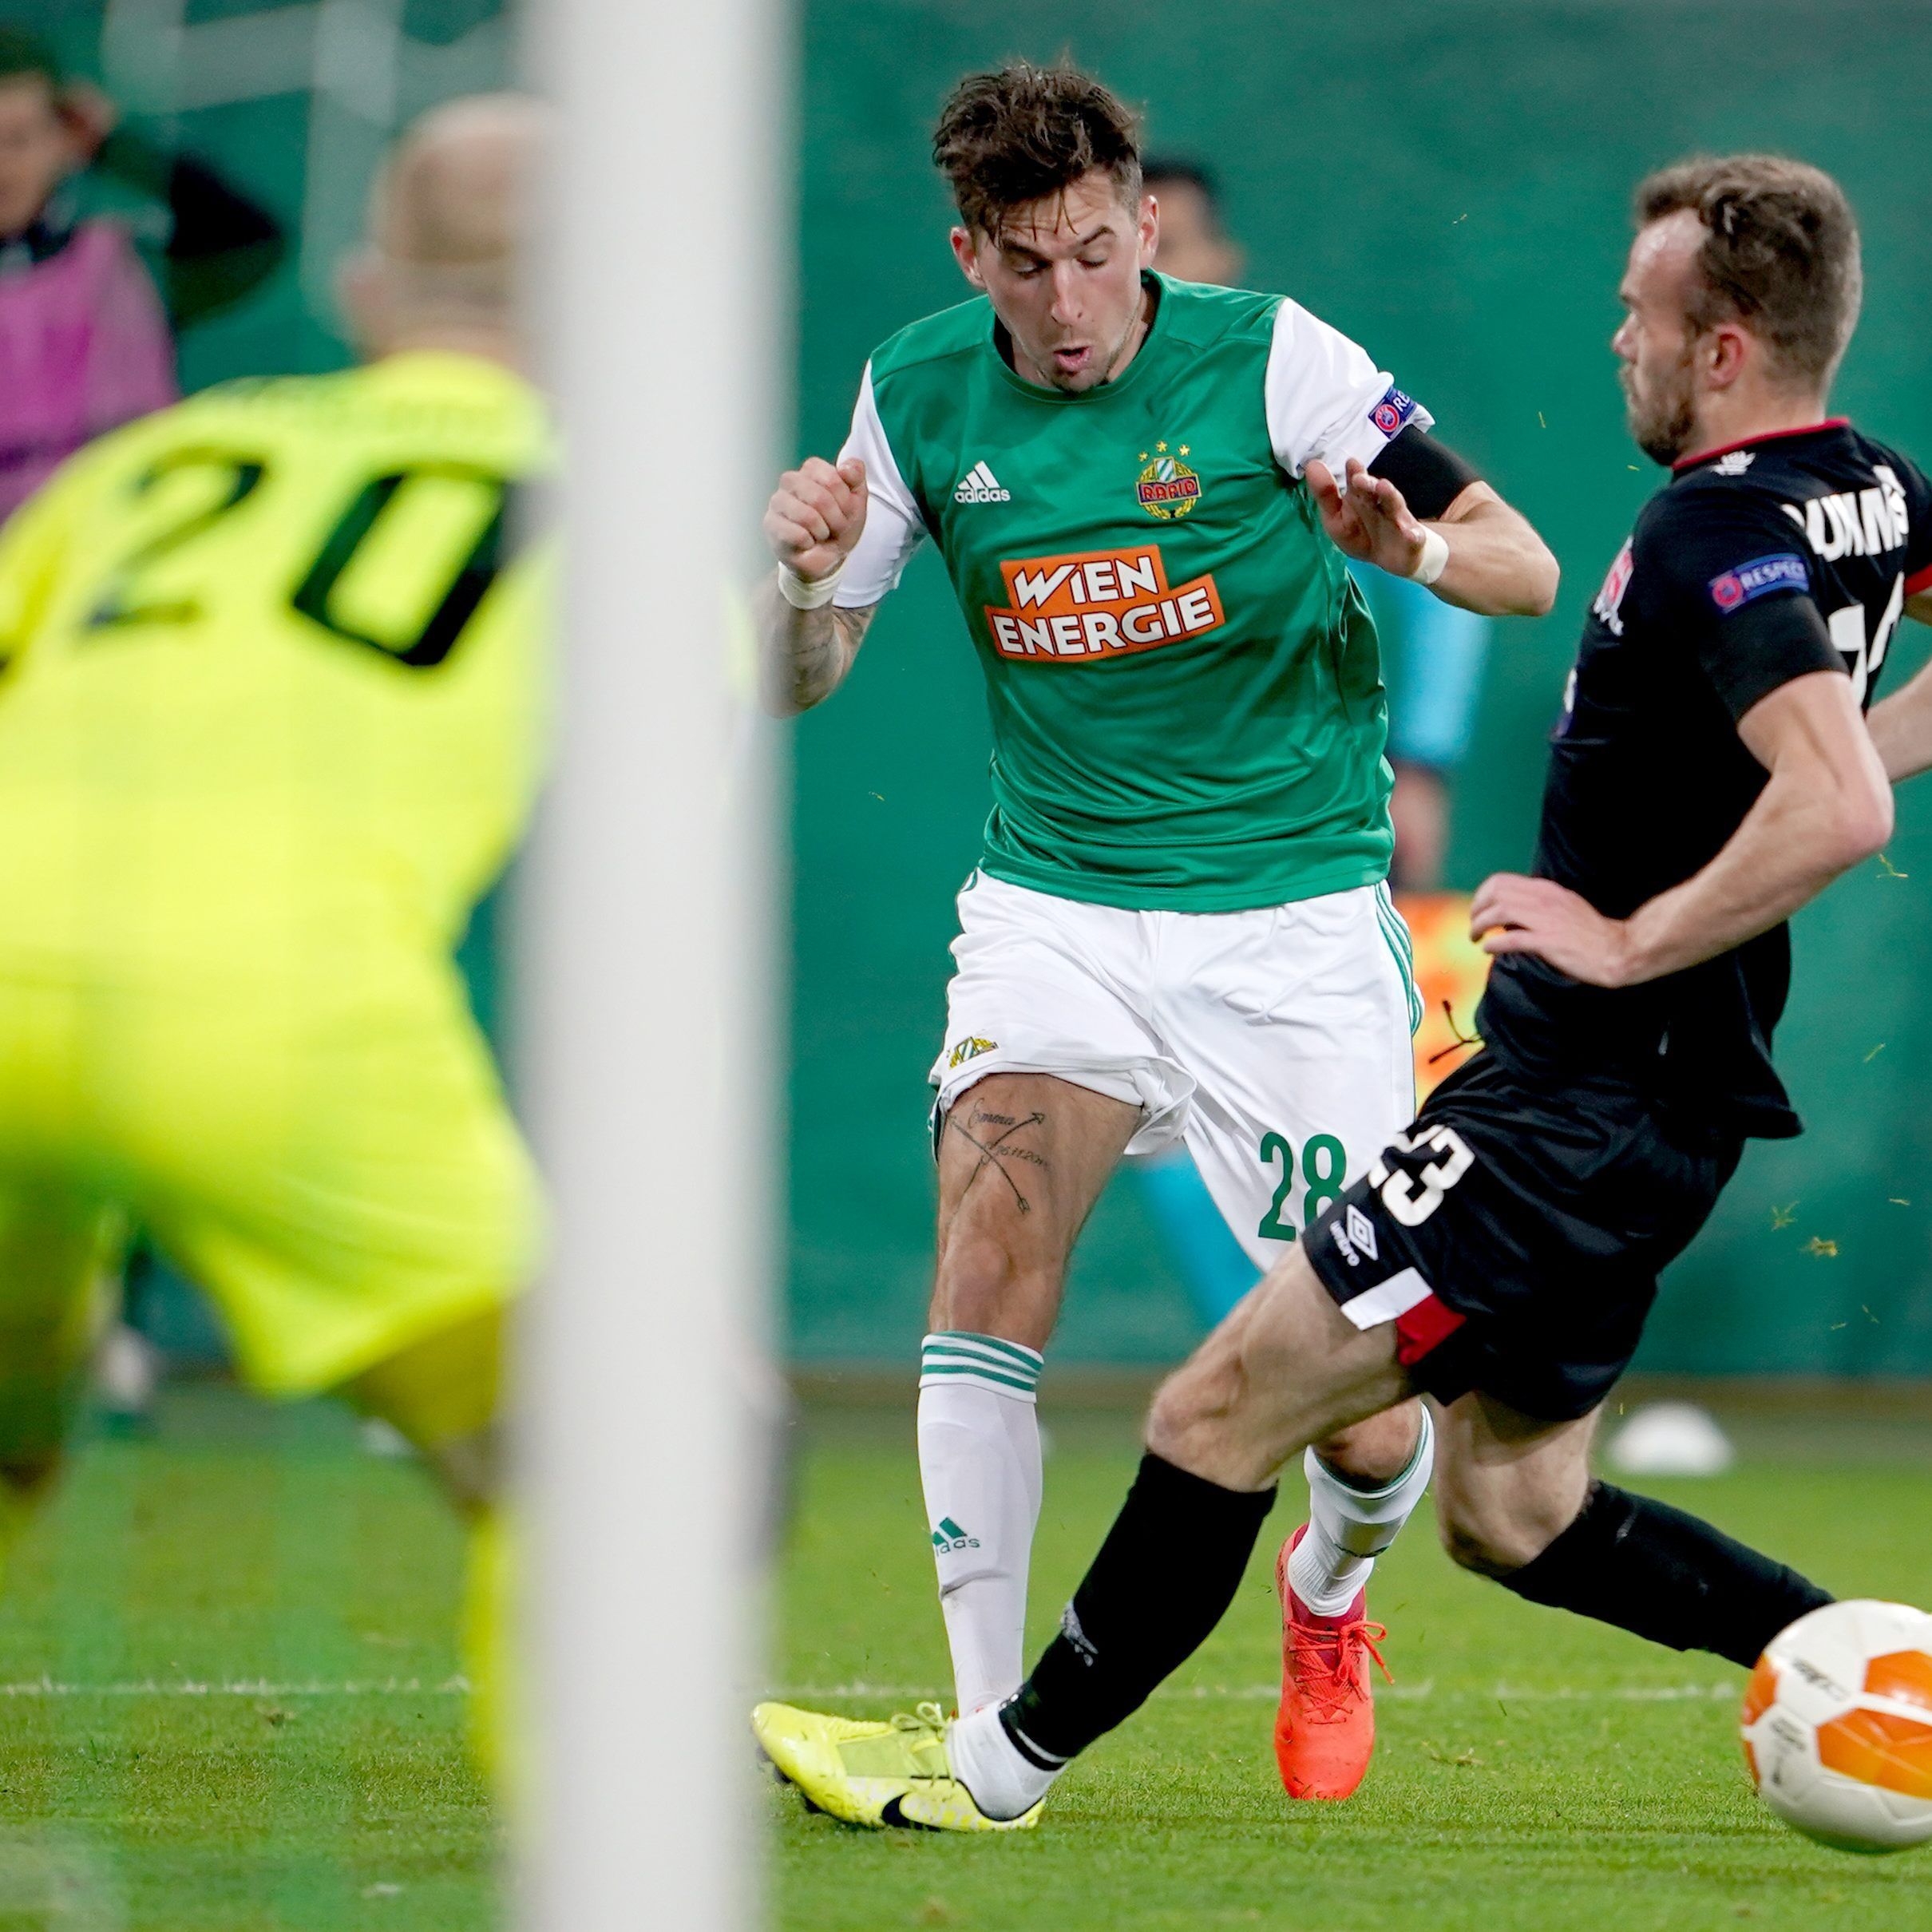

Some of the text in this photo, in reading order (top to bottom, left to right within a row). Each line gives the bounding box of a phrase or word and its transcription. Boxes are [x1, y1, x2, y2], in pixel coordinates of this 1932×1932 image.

[954, 487, 1012, 504] adidas
[1141, 478, 1196, 501] RAPID
[80, 445, 506, 669] 20
[1012, 555, 1161, 610] WIEN
[992, 586, 1216, 657] ENERGIE
[1257, 1130, 1348, 1242] 28
